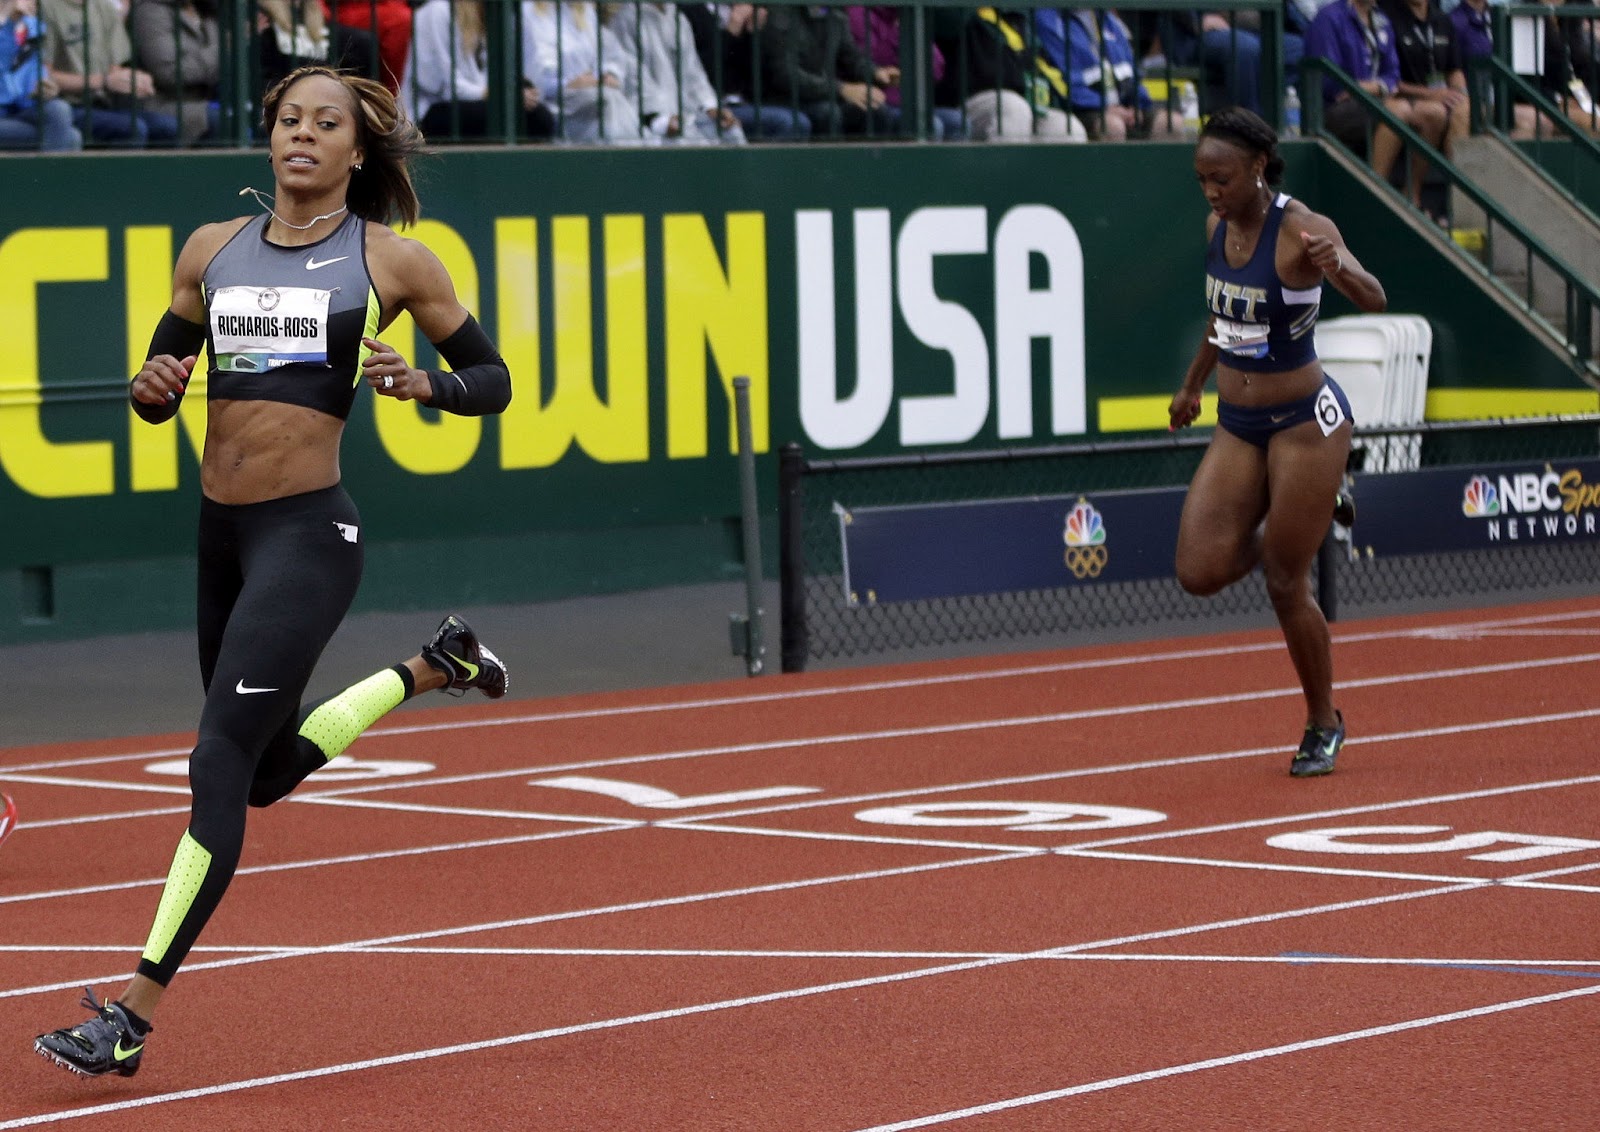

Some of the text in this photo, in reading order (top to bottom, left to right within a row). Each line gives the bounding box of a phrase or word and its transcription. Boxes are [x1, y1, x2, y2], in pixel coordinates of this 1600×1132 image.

[217, 314, 318, 338] RICHARDS-ROSS
[795, 203, 1087, 449] USA
[1317, 394, 1338, 427] 6
[1498, 472, 1562, 514] NBC
